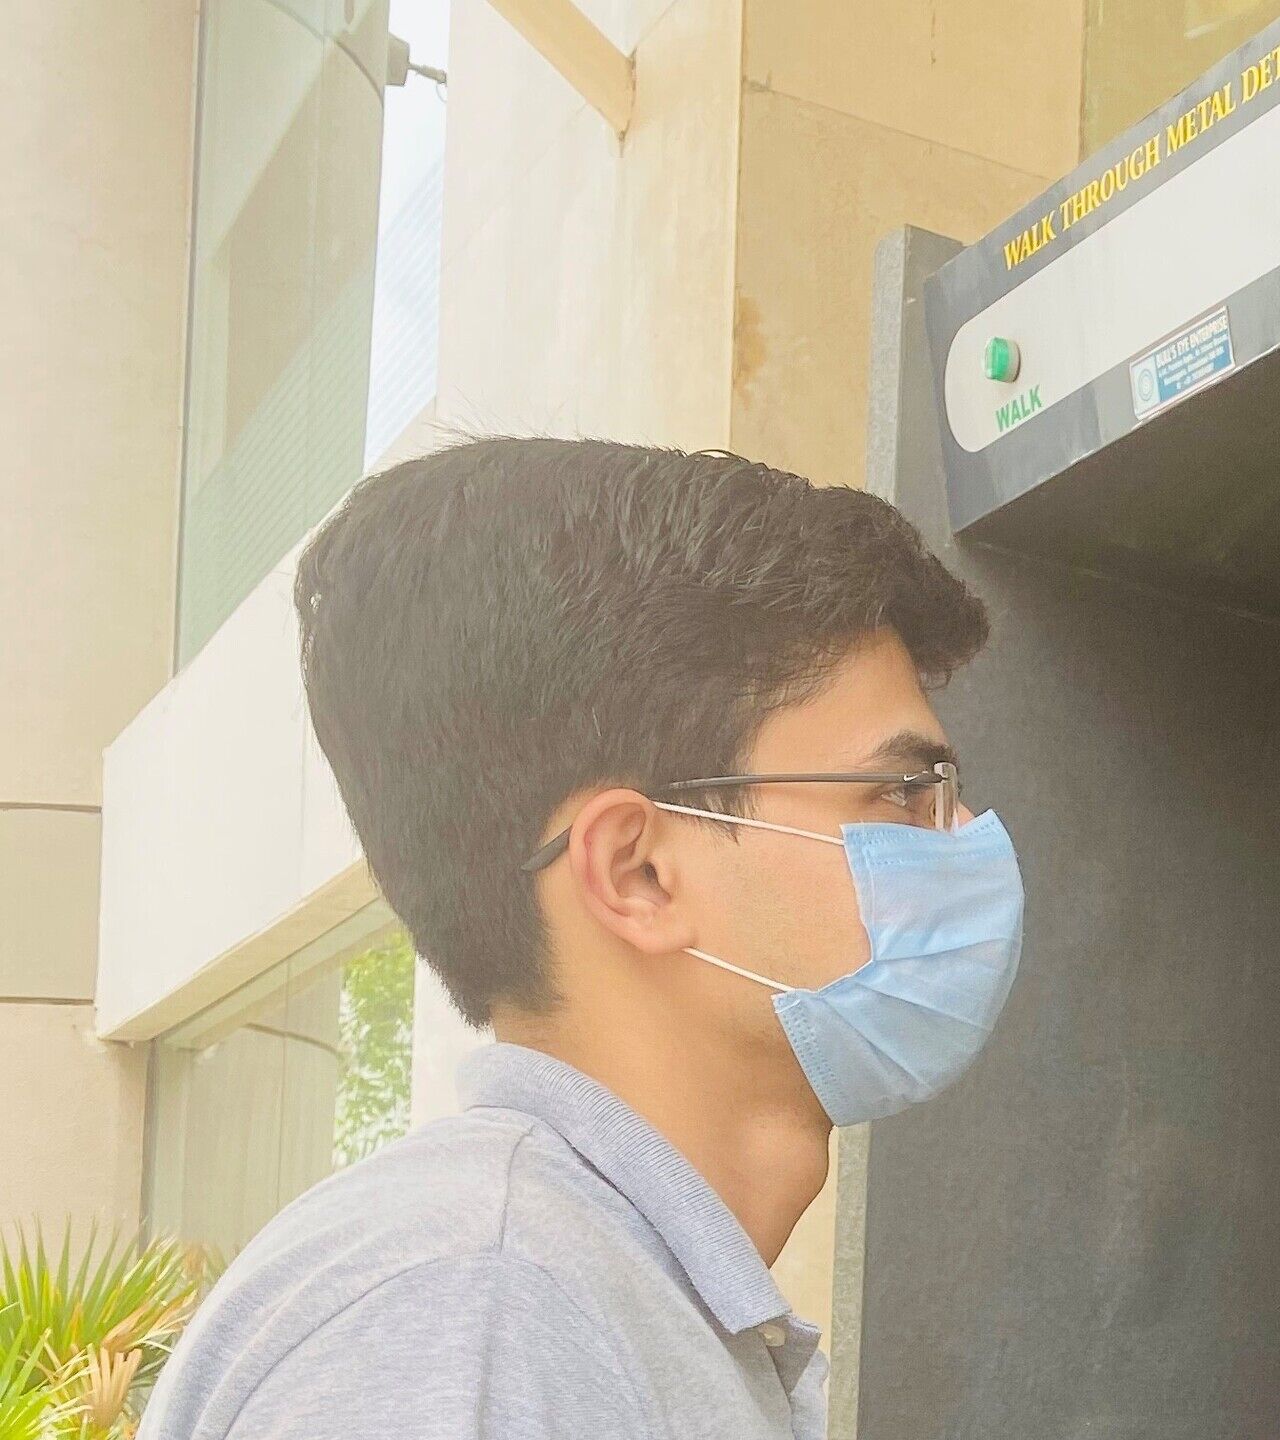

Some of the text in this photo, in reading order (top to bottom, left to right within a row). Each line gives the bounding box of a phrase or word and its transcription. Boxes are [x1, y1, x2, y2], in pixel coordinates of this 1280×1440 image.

[1003, 210, 1057, 271] WALK
[1060, 136, 1160, 232] THROUGH
[1166, 82, 1237, 158] METAL
[995, 385, 1042, 432] WALK
